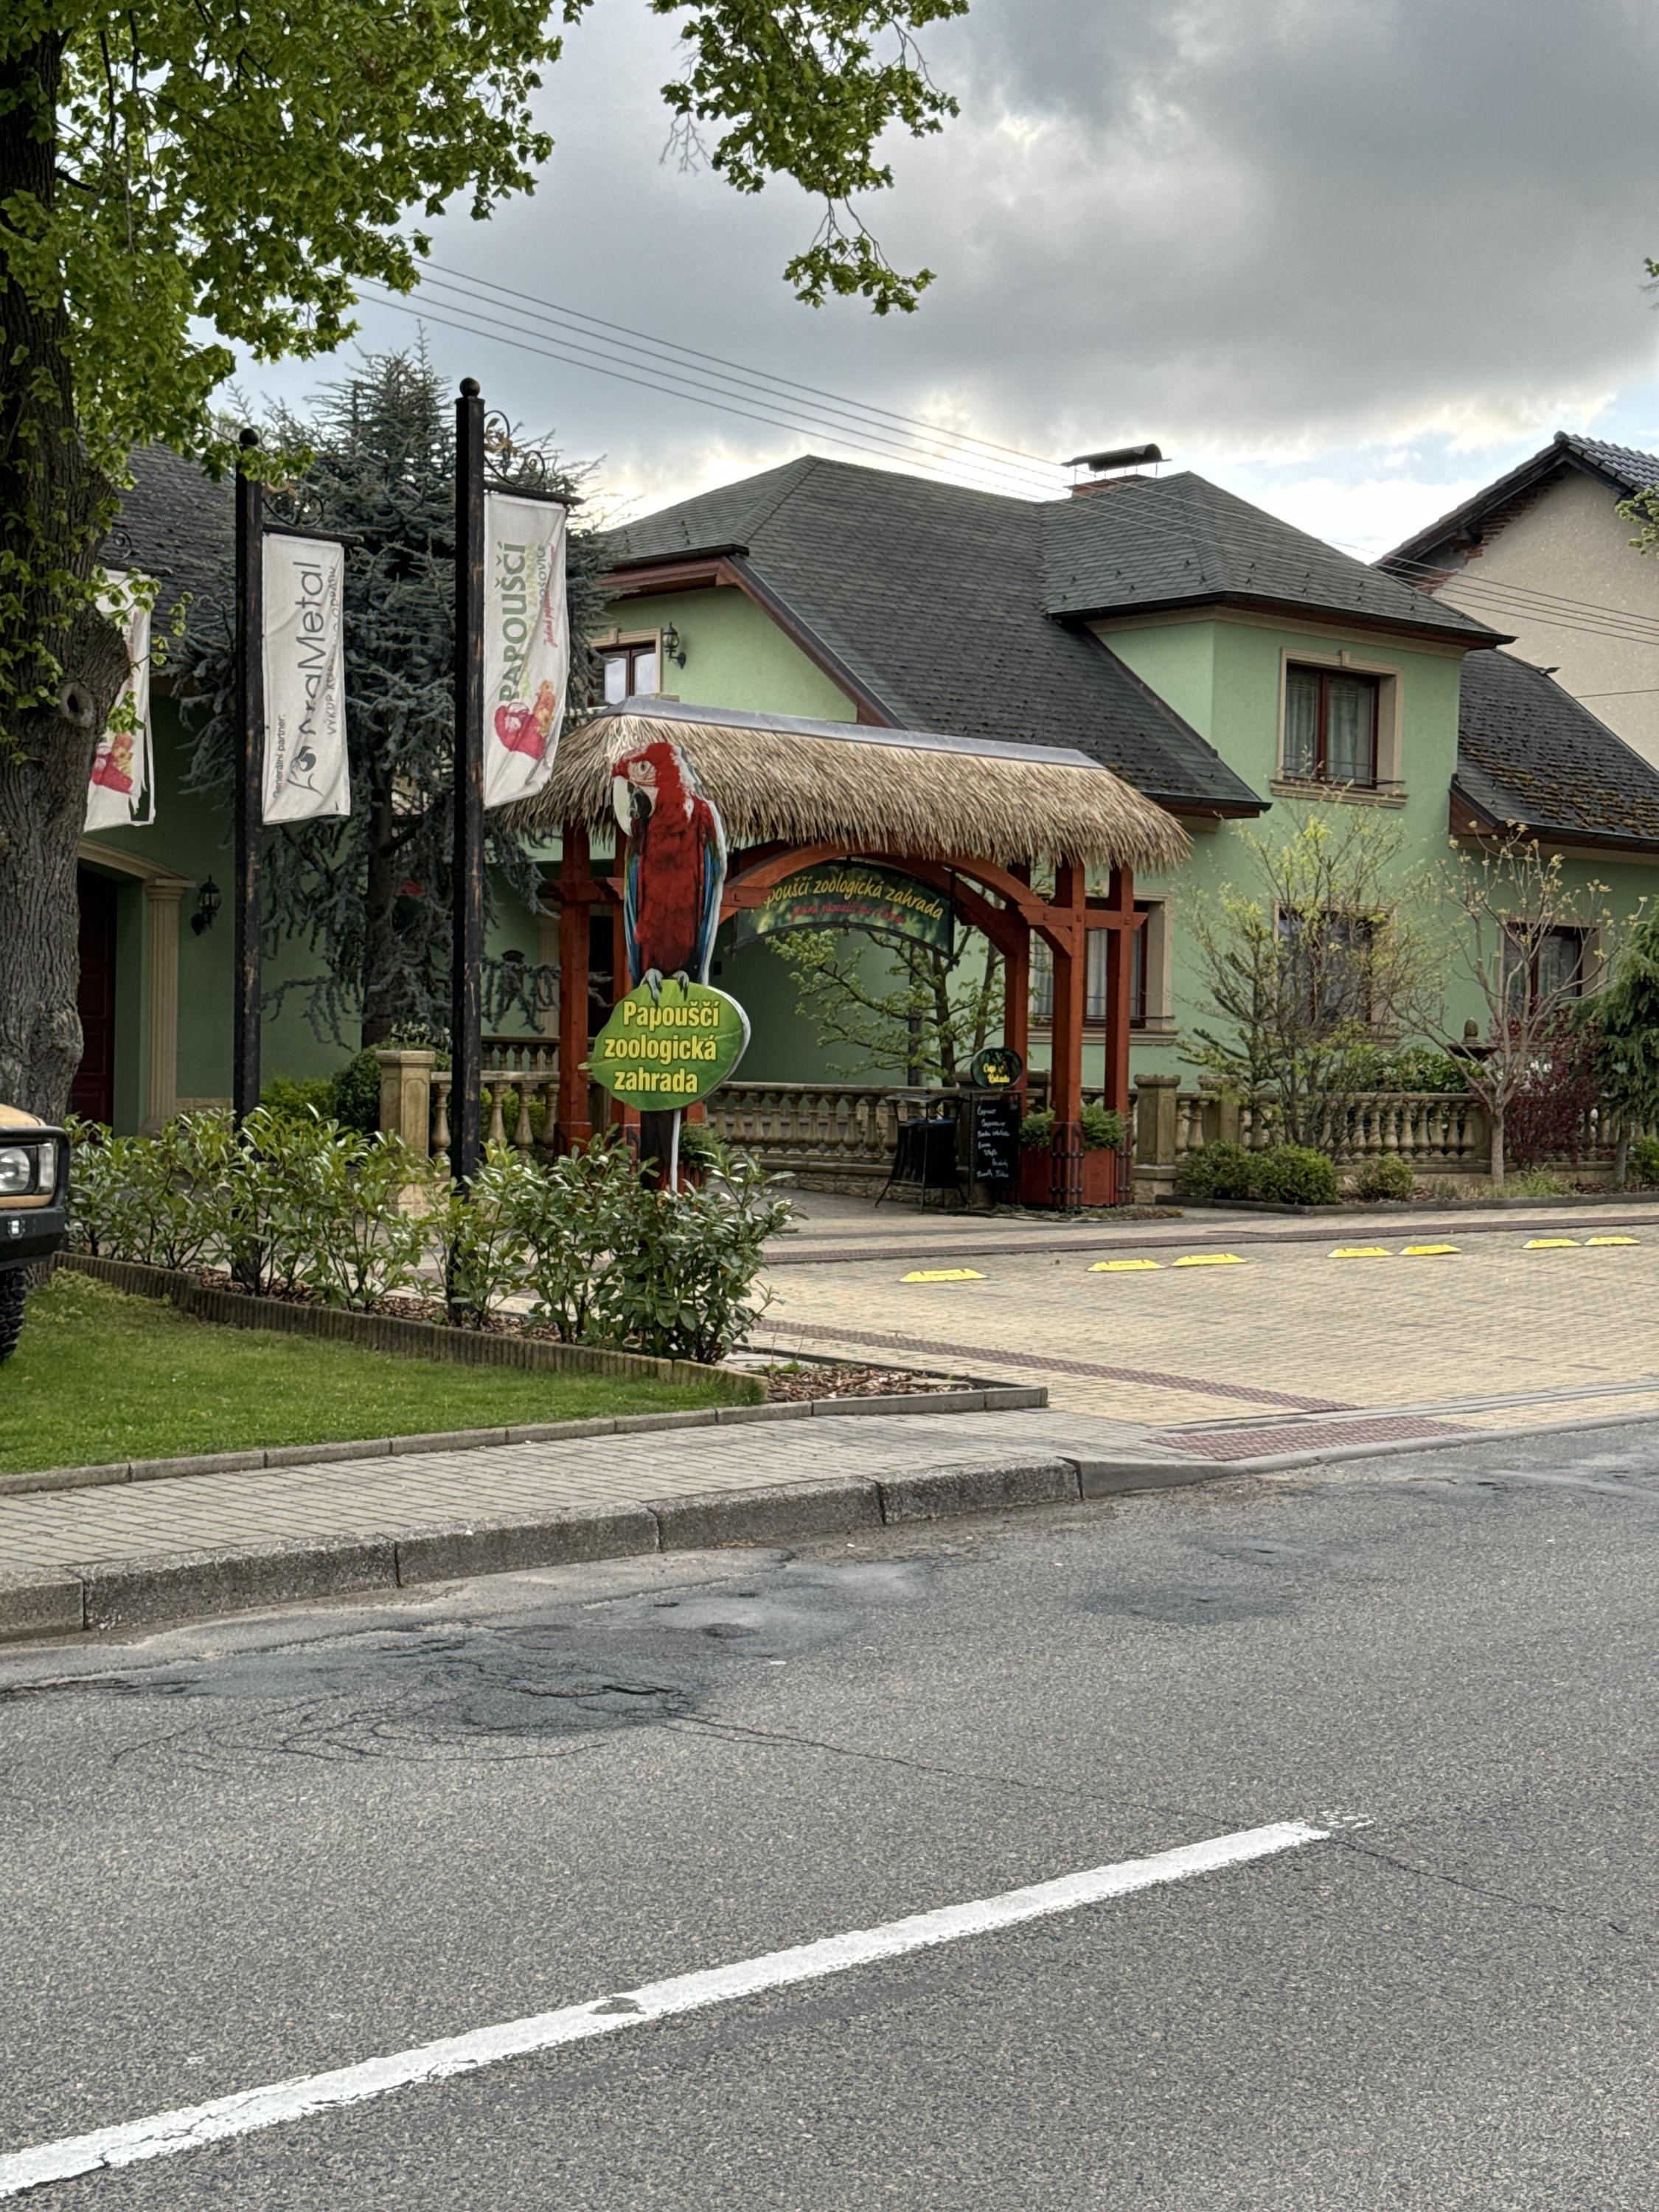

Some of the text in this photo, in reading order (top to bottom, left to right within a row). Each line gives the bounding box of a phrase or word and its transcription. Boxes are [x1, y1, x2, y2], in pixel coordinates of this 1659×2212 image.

[494, 541, 528, 702] PAPOUŠČÍ
[276, 714, 286, 752] partner:
[764, 875, 813, 911] pouščí
[813, 871, 885, 900] zoologická
[885, 888, 944, 921] zahrada
[623, 1000, 720, 1032] Papouščí
[603, 1034, 717, 1065] zoologická
[613, 1066, 699, 1093] zahrada
